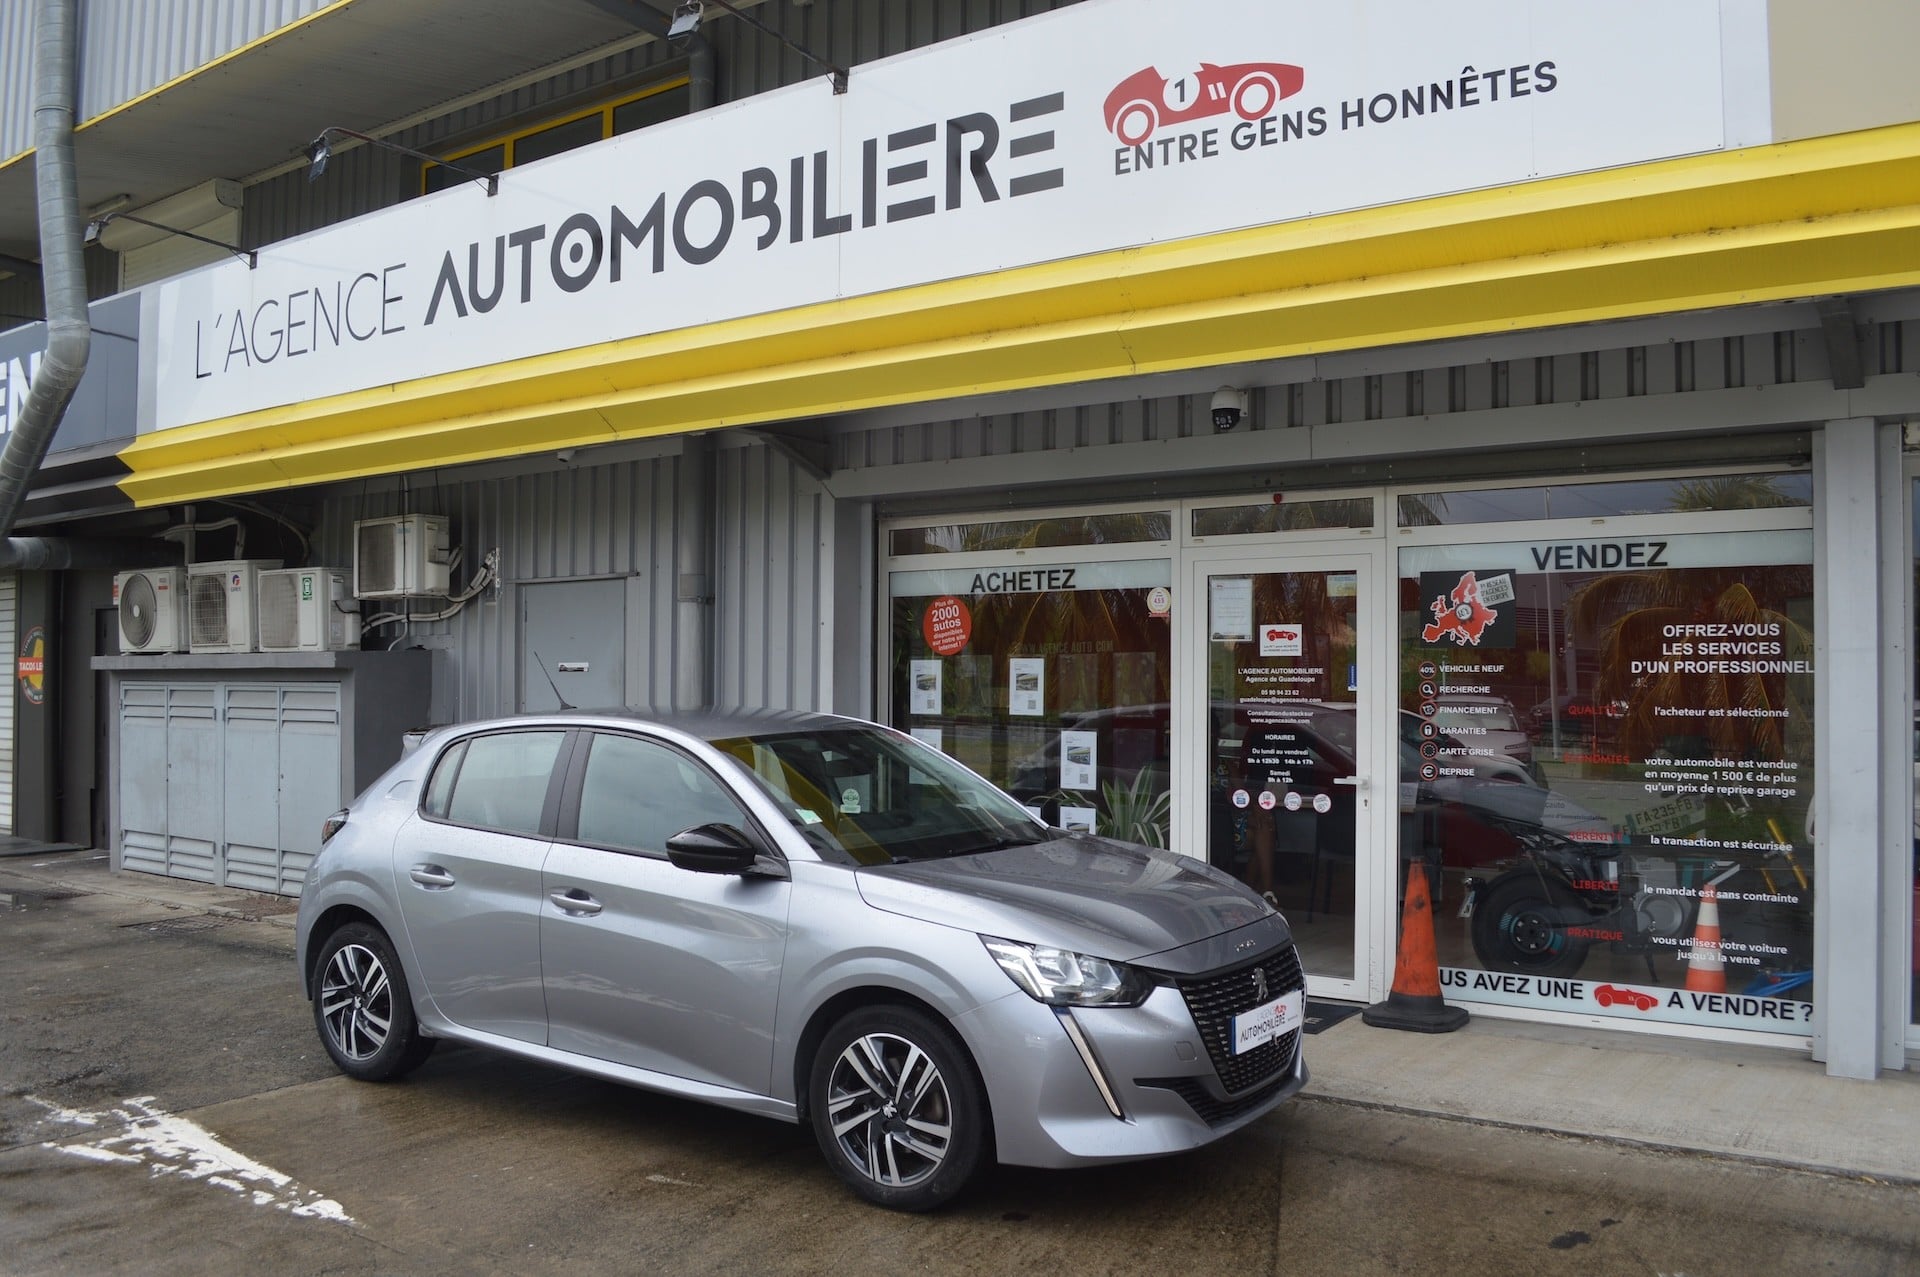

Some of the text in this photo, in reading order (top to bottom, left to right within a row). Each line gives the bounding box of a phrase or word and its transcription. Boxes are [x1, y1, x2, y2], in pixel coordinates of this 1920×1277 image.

[1115, 61, 1558, 175] ENTRE GENS HONNÊTES
[196, 91, 1064, 379] L'AGENCE AUTOMOBILIERE
[1530, 542, 1668, 570] VENDEZ
[970, 568, 1076, 593] ACHETEZ
[932, 604, 960, 622] 2000
[933, 618, 961, 632] autos
[1662, 623, 1780, 638] OFFREZ-VOUS
[1662, 642, 1781, 655] LES SERVICES
[1237, 667, 1324, 675] L'AGENCE AUTOMOBILIERE
[1420, 664, 1505, 674] 40% VEHICULE NEUF
[1631, 660, 1814, 674] D'UN PROFESSIONNEL
[1278, 675, 1316, 683] Guadeloupe
[1439, 685, 1491, 694] RECHERCHE
[1439, 706, 1498, 715] FINANCEMENT
[1654, 706, 1790, 718] l'acheteur est sélectionné
[1439, 727, 1487, 736] GARANTIES
[1439, 747, 1495, 757] CARTE GRISE
[1644, 757, 1798, 769] votre automobile est vendue
[1439, 767, 1475, 776] REPRISE
[1644, 770, 1797, 784] en moyenne 1 500 € de plus
[1644, 782, 1797, 799] qu'un prix de reprise garage
[1650, 834, 1794, 852] la transaction est sécurisée
[1643, 884, 1799, 904] le mandat est sans contrainte
[1566, 926, 1624, 942] PRATIQUE
[1652, 936, 1788, 955] vous utilisez votre voiture
[1717, 952, 1728, 962] la
[1730, 956, 1761, 966] vente
[1440, 970, 1814, 1022] US AVEZ UNE A VENDRE ?
